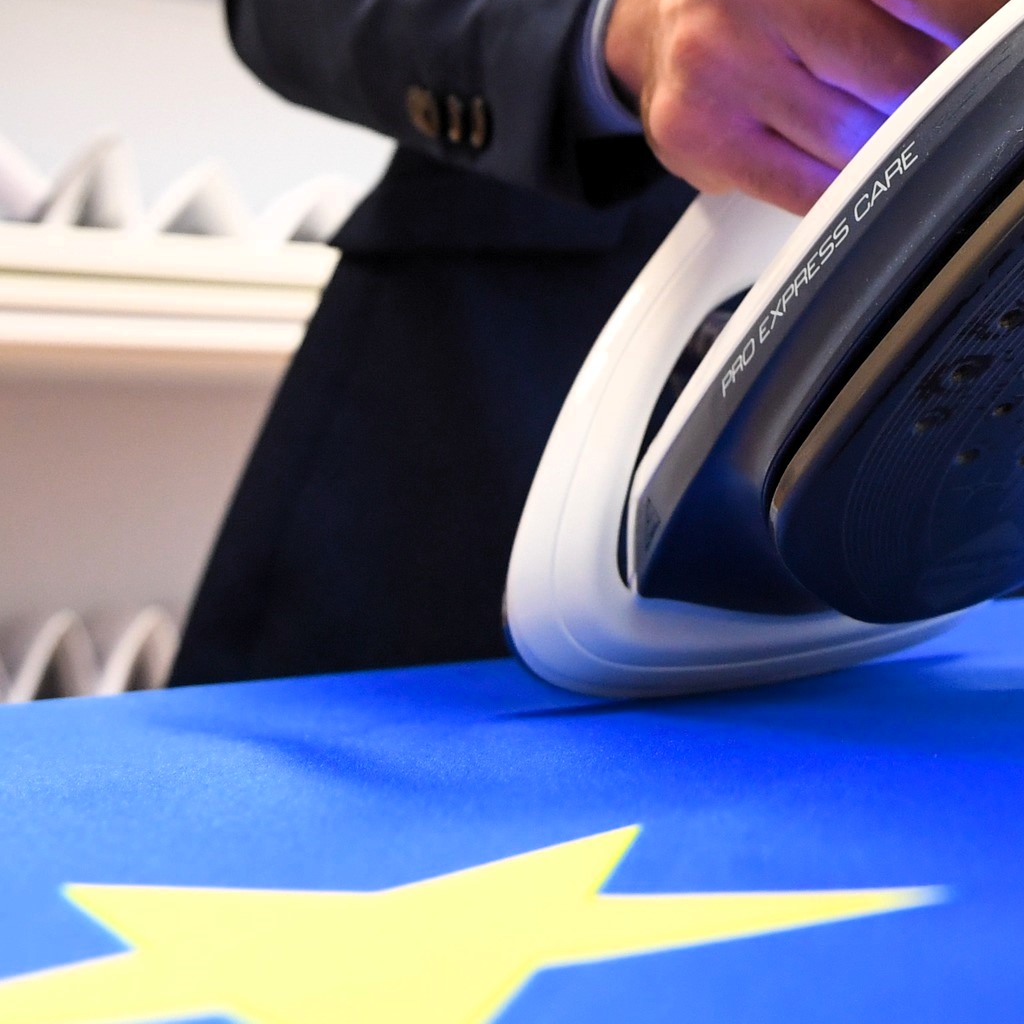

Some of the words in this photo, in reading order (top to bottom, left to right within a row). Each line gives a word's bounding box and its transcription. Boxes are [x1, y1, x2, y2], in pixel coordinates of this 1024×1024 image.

[721, 337, 756, 398] PRO
[758, 217, 850, 345] EXPRESS
[854, 140, 919, 222] CARE
